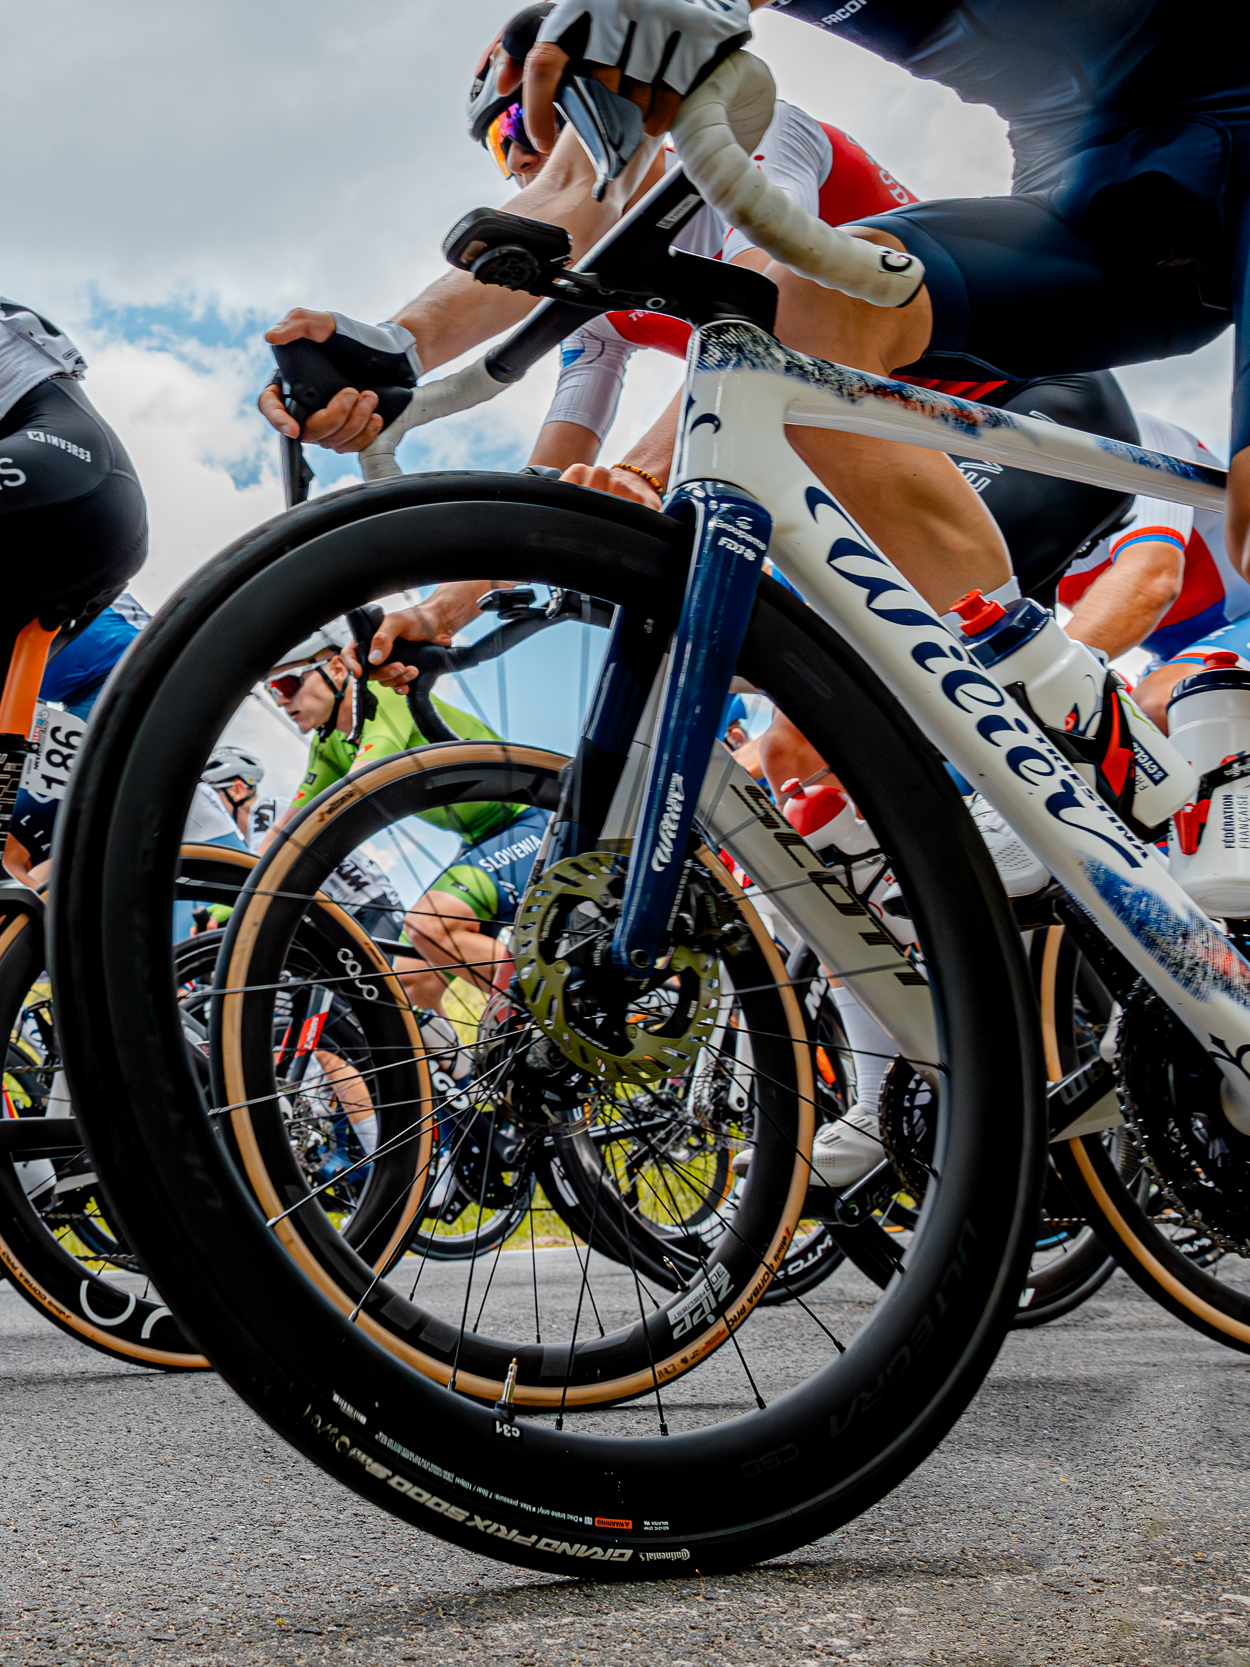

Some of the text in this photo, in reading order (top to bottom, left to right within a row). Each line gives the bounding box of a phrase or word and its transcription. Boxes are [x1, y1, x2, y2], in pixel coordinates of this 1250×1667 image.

[804, 485, 1144, 870] Wilier
[40, 725, 84, 791] 186
[478, 834, 544, 873] SLOVENIA
[387, 1474, 472, 1524] 5000
[463, 1514, 539, 1548] PRIX
[534, 1536, 634, 1563] GRAND
[646, 1548, 691, 1562] Continental
